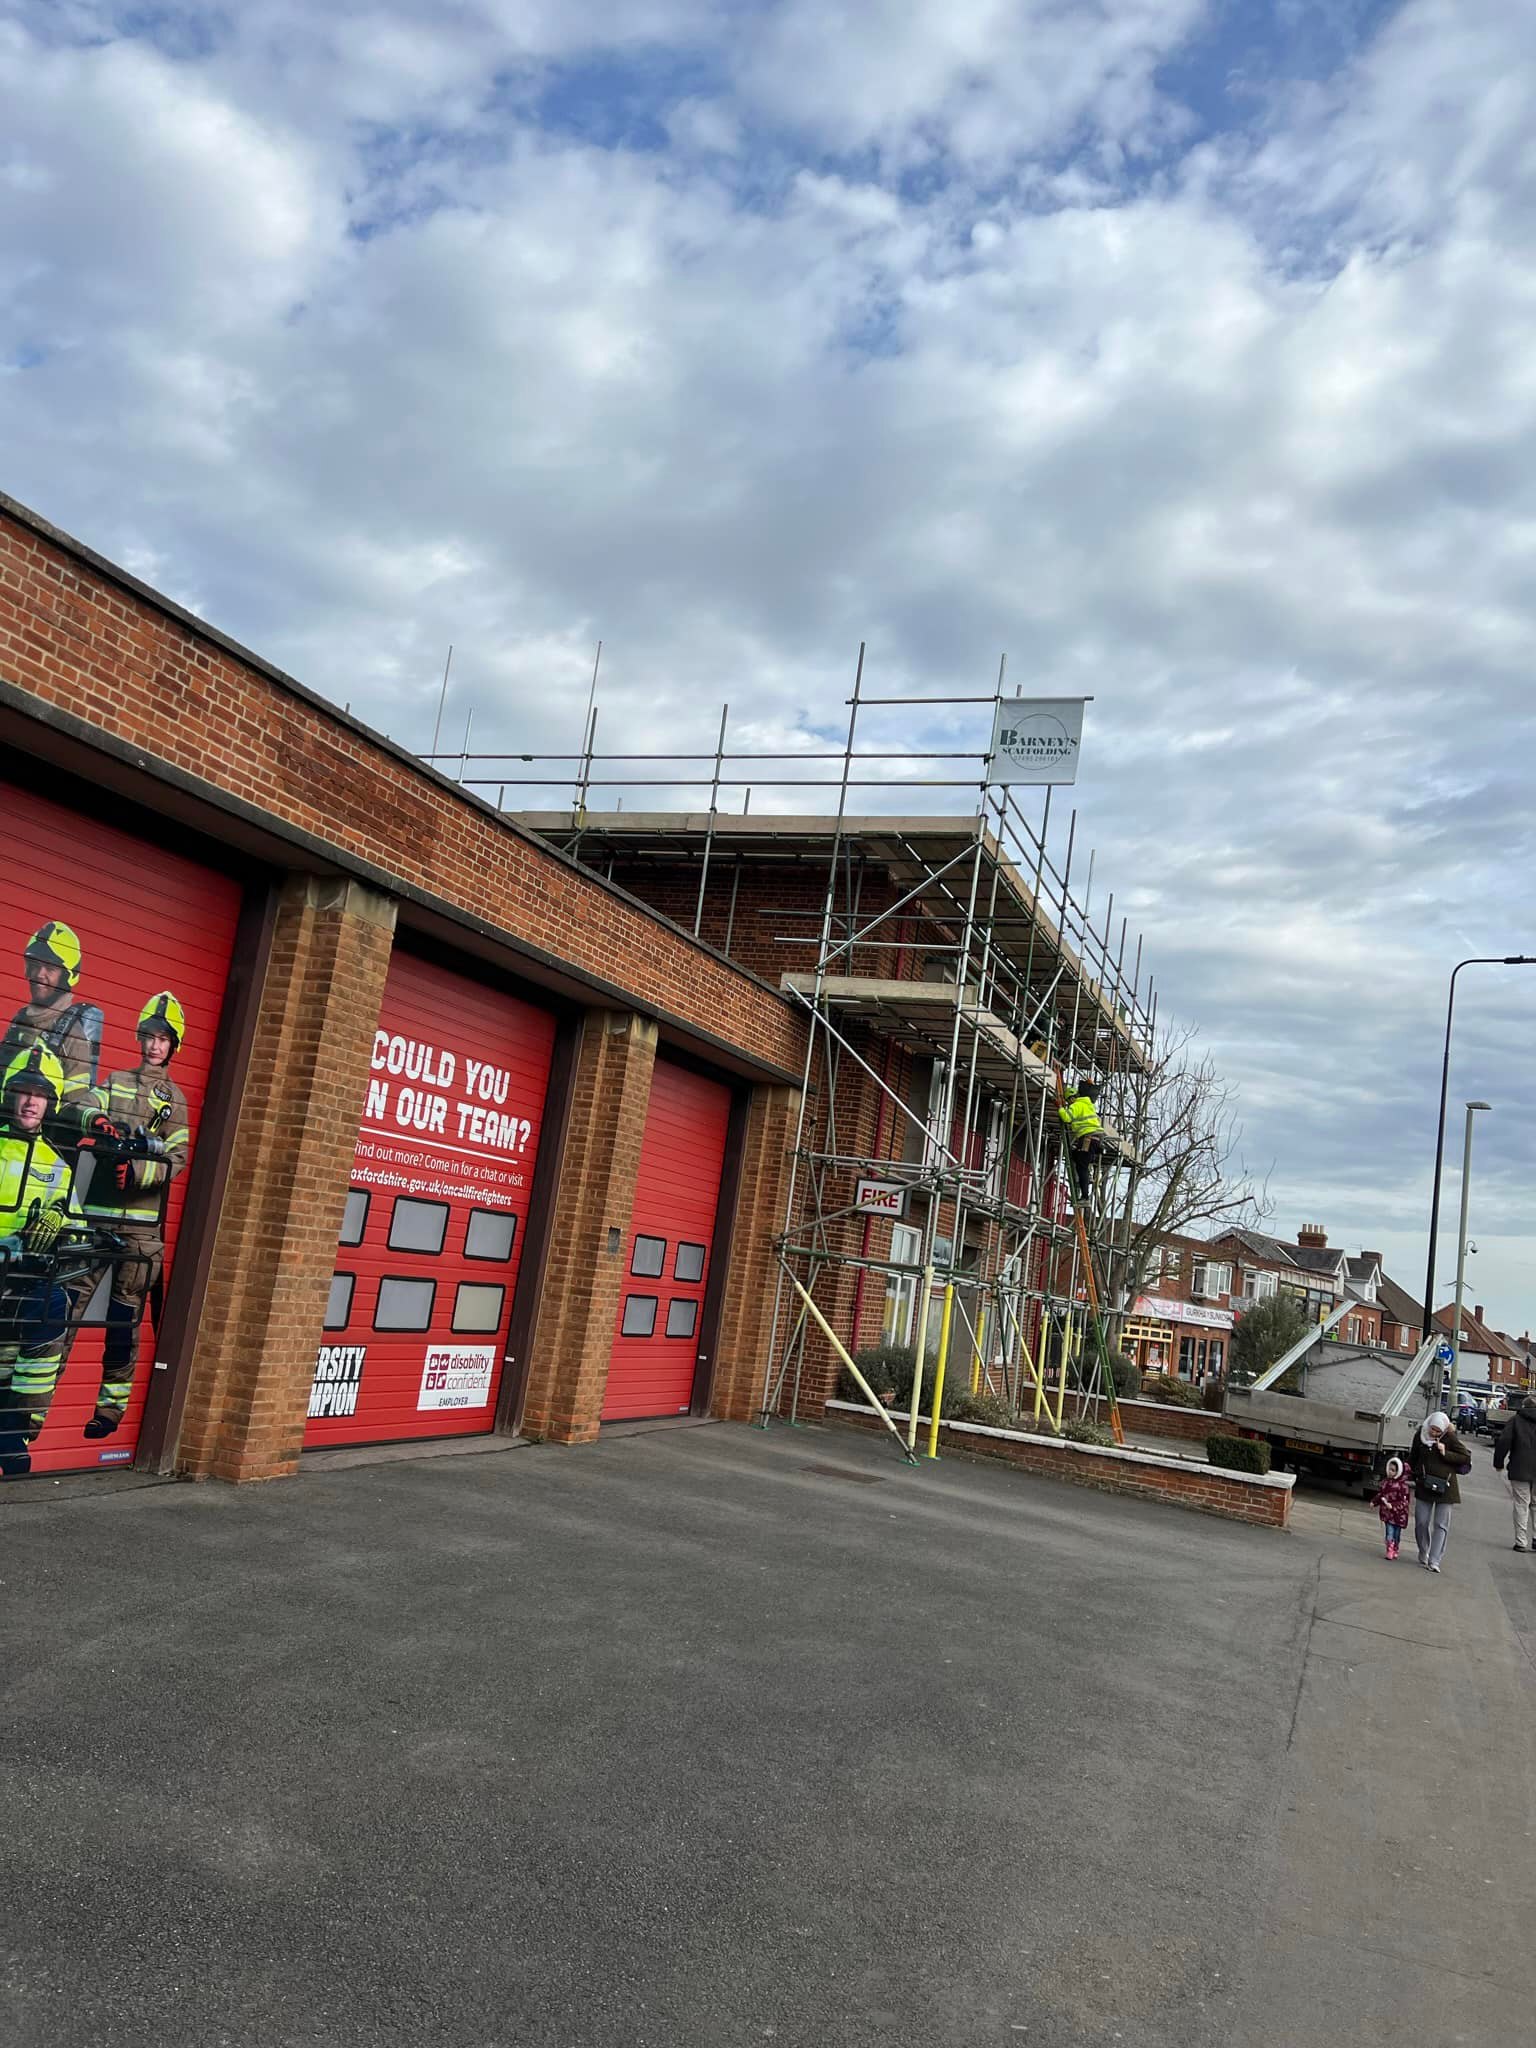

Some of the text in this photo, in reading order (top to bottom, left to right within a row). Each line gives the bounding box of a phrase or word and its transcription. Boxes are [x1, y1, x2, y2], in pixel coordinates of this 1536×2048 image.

[1000, 729, 1078, 746] BARNEY'S
[371, 1030, 511, 1104] COULD YOU
[363, 1079, 531, 1153] N OUR TEAM?
[376, 1147, 393, 1161] out
[394, 1151, 424, 1167] more?
[424, 1155, 450, 1172] Come
[450, 1160, 459, 1174] in
[460, 1161, 473, 1177] for
[473, 1167, 479, 1178] a
[480, 1166, 498, 1182] chat
[498, 1171, 507, 1183] or
[508, 1172, 523, 1187] visit
[350, 1167, 512, 1206] oxfordshire.gov.uk/oncallfirefighters
[861, 1188, 899, 1208] FIRE
[314, 1346, 366, 1380] RSITY
[450, 1353, 490, 1374] disability
[446, 1372, 488, 1390] confident
[438, 1397, 469, 1407] EMPLOYER
